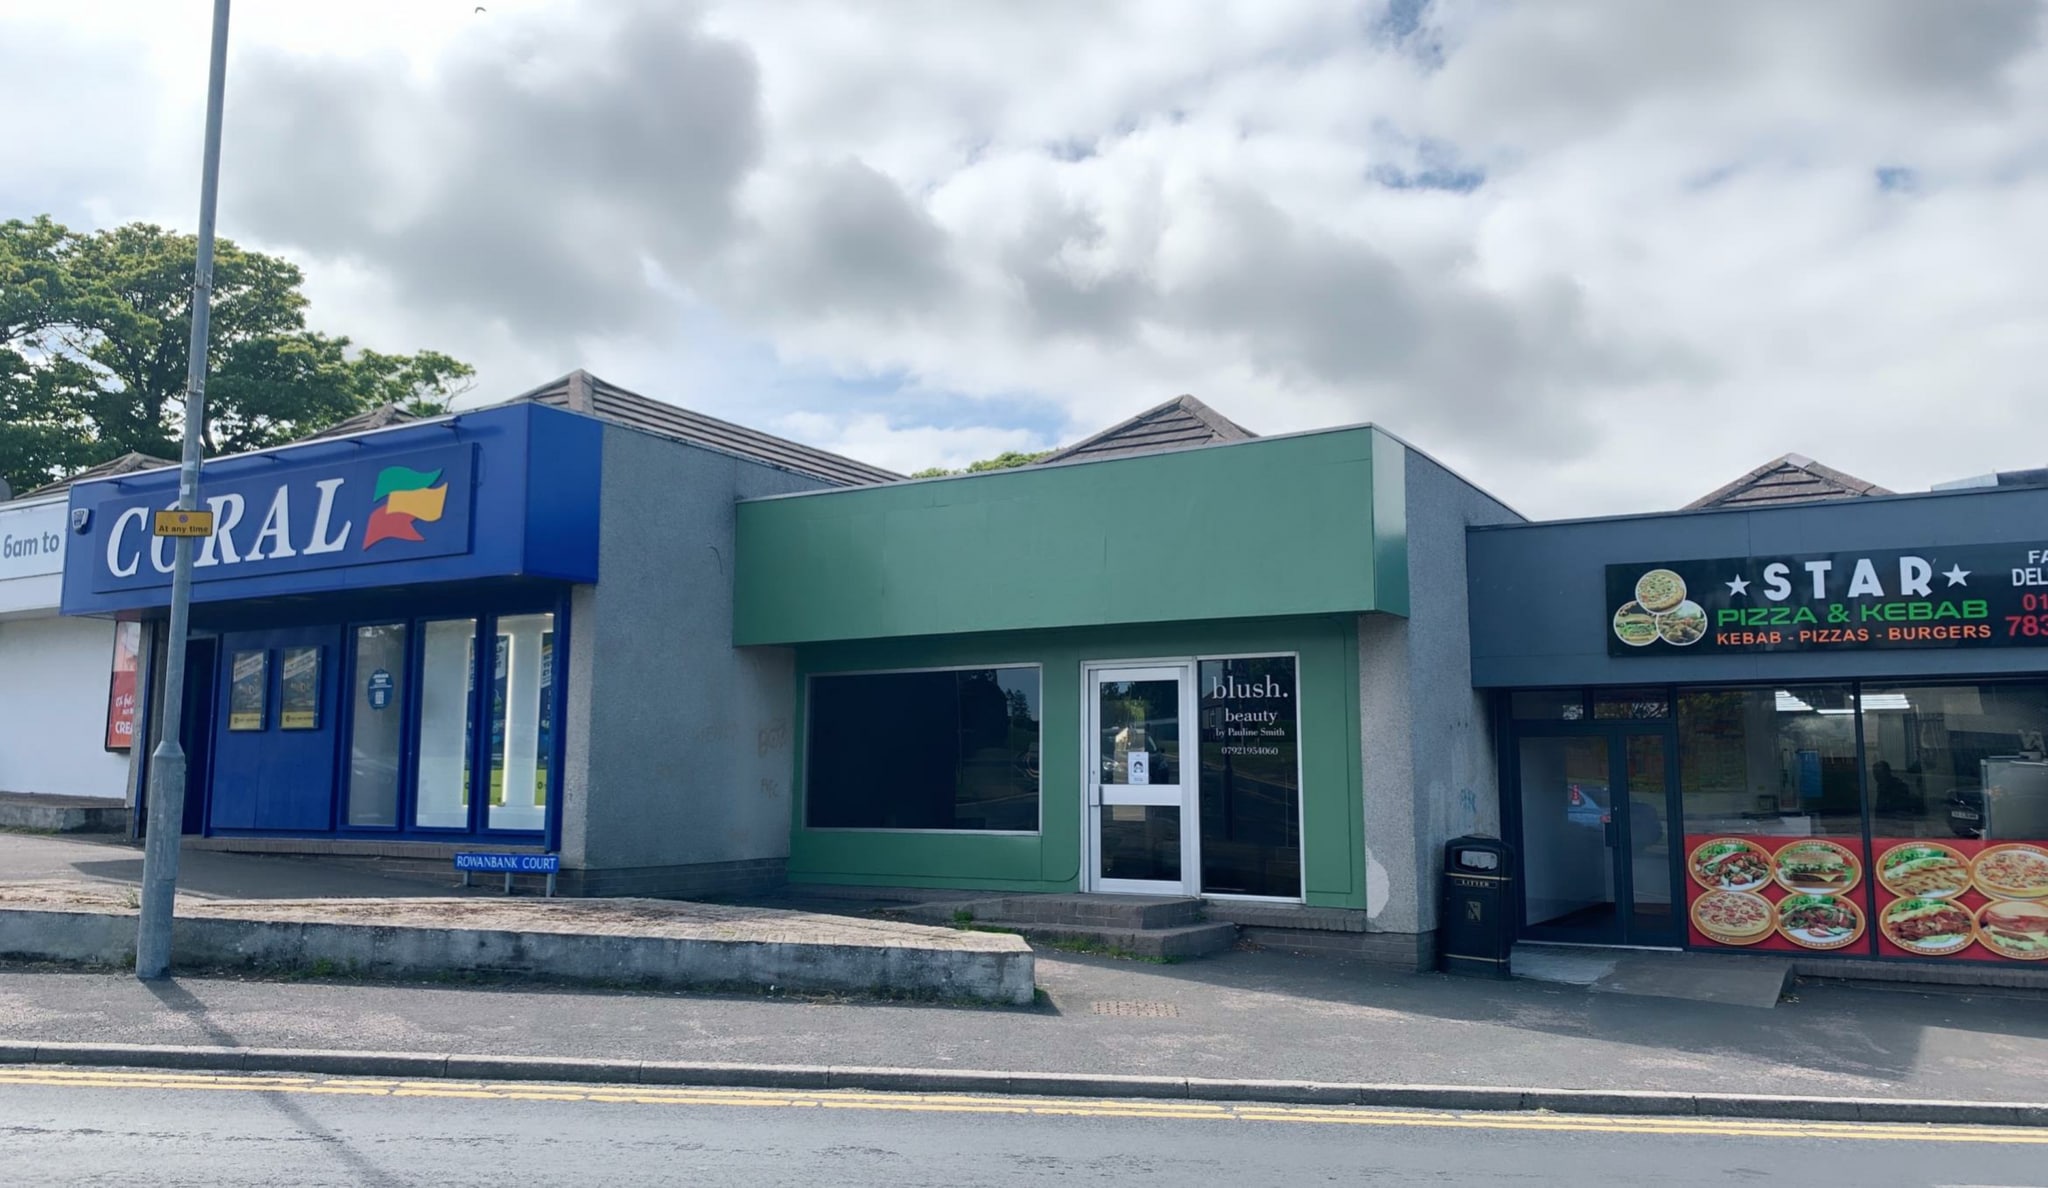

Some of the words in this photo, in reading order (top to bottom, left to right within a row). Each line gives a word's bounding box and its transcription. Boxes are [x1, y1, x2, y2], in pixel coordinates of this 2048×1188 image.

[158, 524, 168, 532] At
[171, 526, 187, 534] any
[189, 525, 208, 533] time
[3, 534, 38, 558] 6am
[42, 531, 60, 553] to
[1763, 556, 1933, 600] STAR
[1717, 606, 1818, 626] PIZZA
[1827, 603, 1850, 623] &
[1861, 600, 1988, 621] KEBAB
[1717, 631, 1781, 645] KEBAB
[1800, 628, 1869, 643] PIZZAS
[1889, 625, 1992, 640] BURGERS
[1211, 674, 1289, 699] blush.
[1225, 707, 1278, 726] beauty
[1215, 727, 1225, 738] by
[1228, 727, 1258, 736] Pauline
[1260, 727, 1285, 736] Smith
[456, 855, 518, 868] ROWANBANK
[522, 857, 557, 870] COURT
